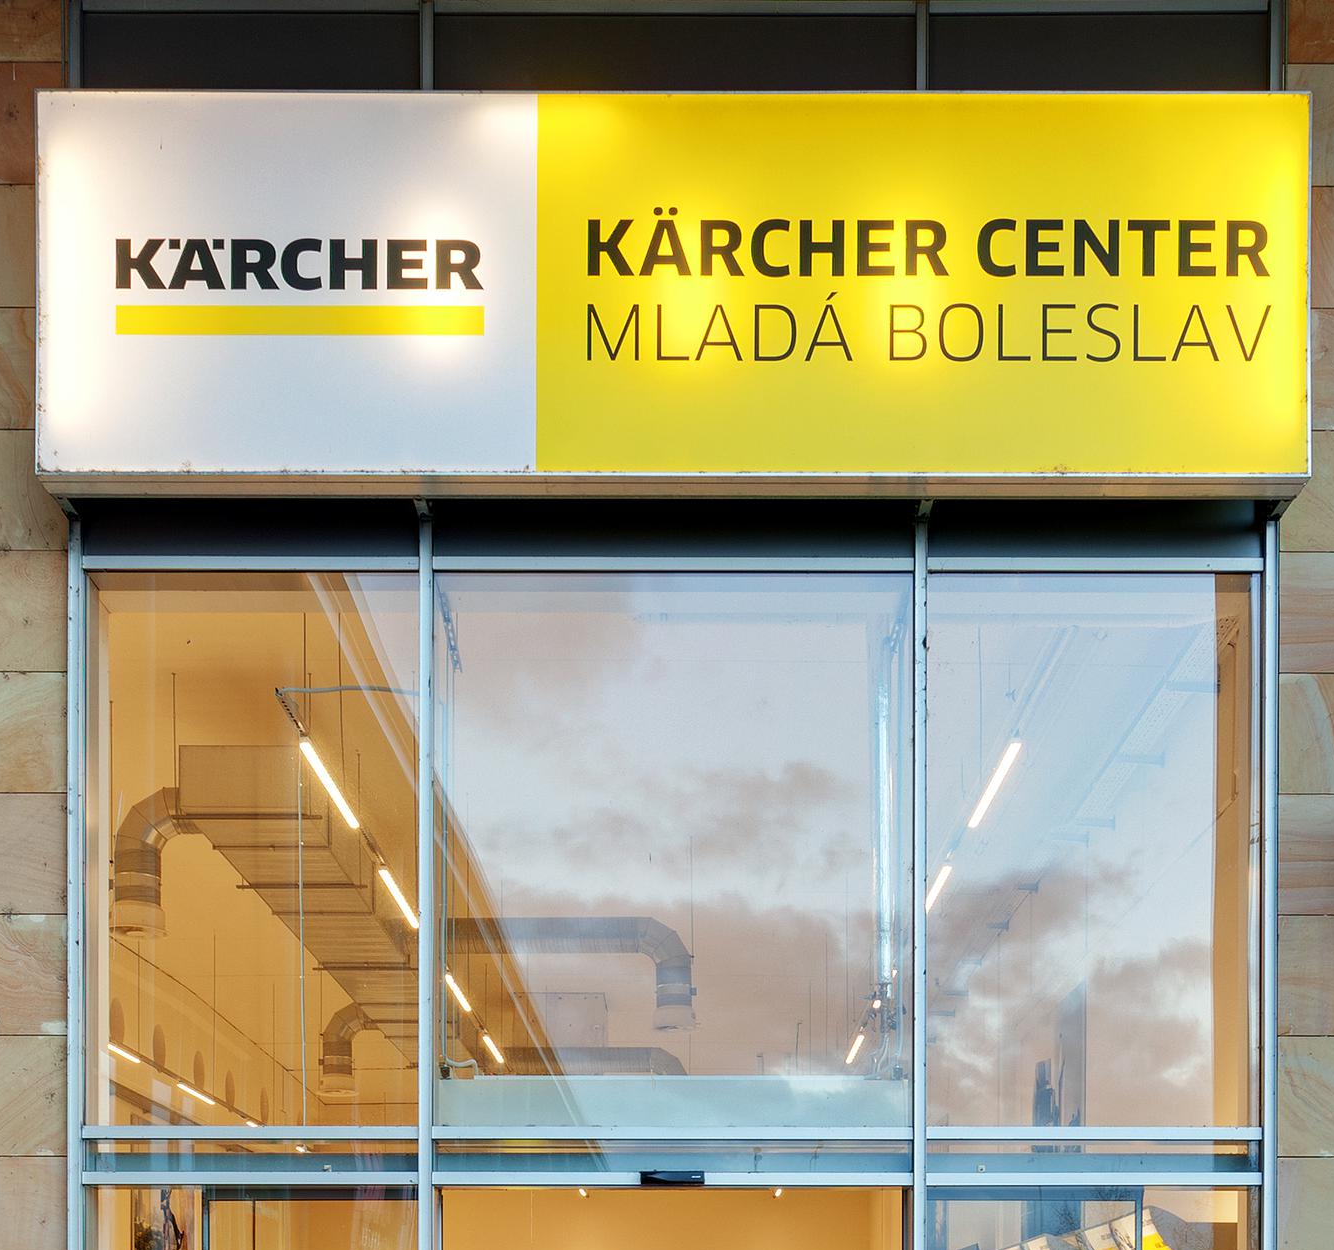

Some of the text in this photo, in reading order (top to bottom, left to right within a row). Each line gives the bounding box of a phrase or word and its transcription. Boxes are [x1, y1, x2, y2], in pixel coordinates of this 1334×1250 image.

[115, 237, 484, 290] KÄRCHER
[587, 207, 1270, 277] KÄRCHER CENTER
[586, 291, 1273, 362] MLADÁ BOLESLAV
